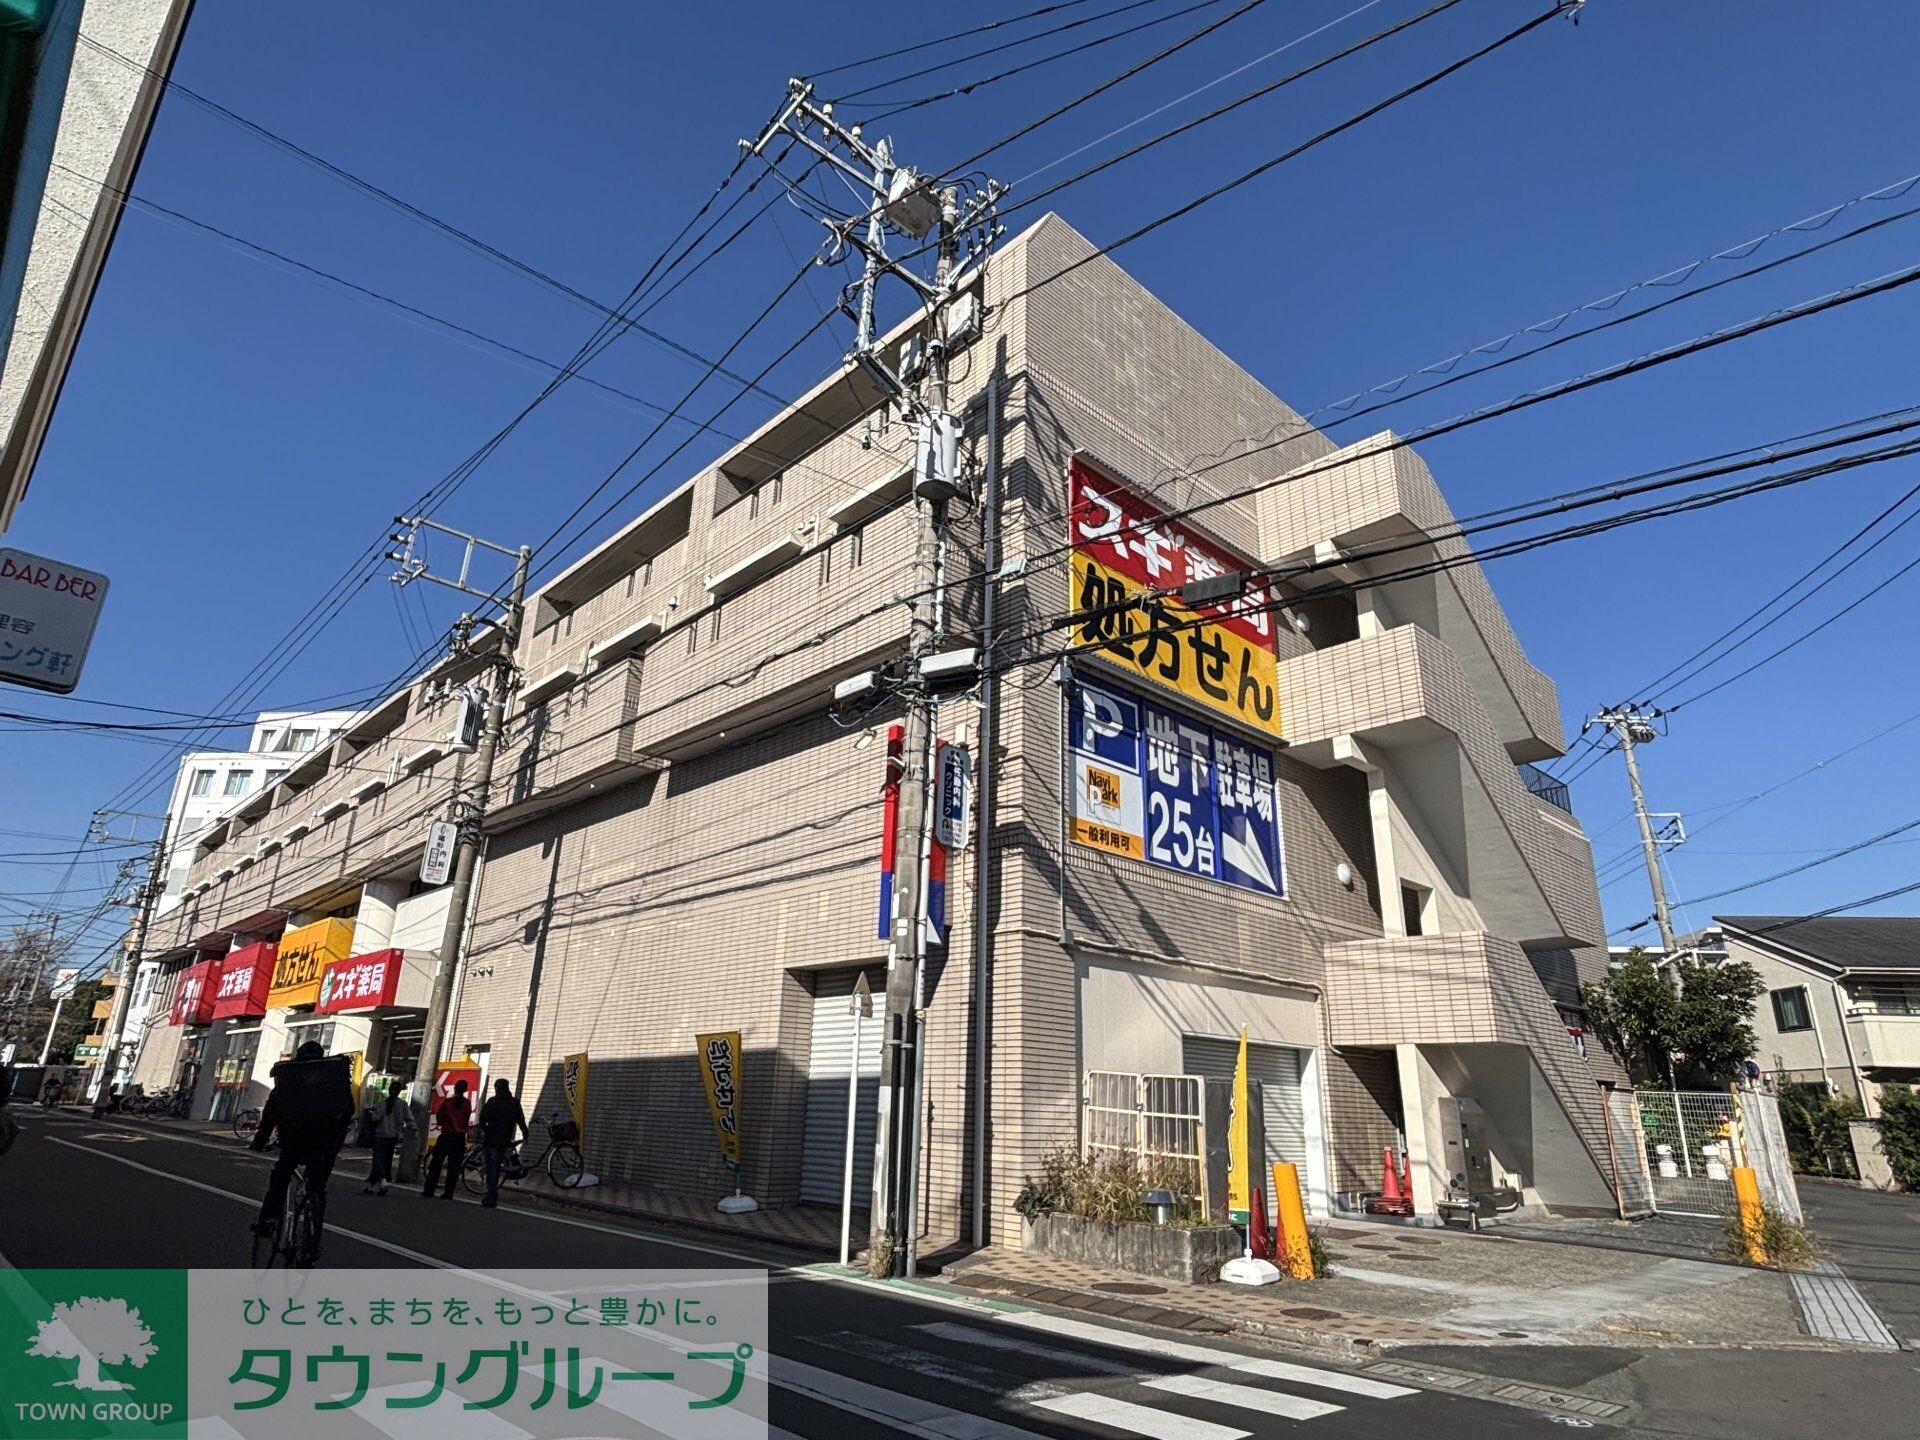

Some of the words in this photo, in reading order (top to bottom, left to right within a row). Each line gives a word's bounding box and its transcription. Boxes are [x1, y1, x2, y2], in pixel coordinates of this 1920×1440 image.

[1080, 562, 1273, 723] 処方せん
[1088, 769, 1111, 790] Navi
[1077, 825, 1130, 851] 一般利用可
[332, 962, 386, 1001] スギ薬局
